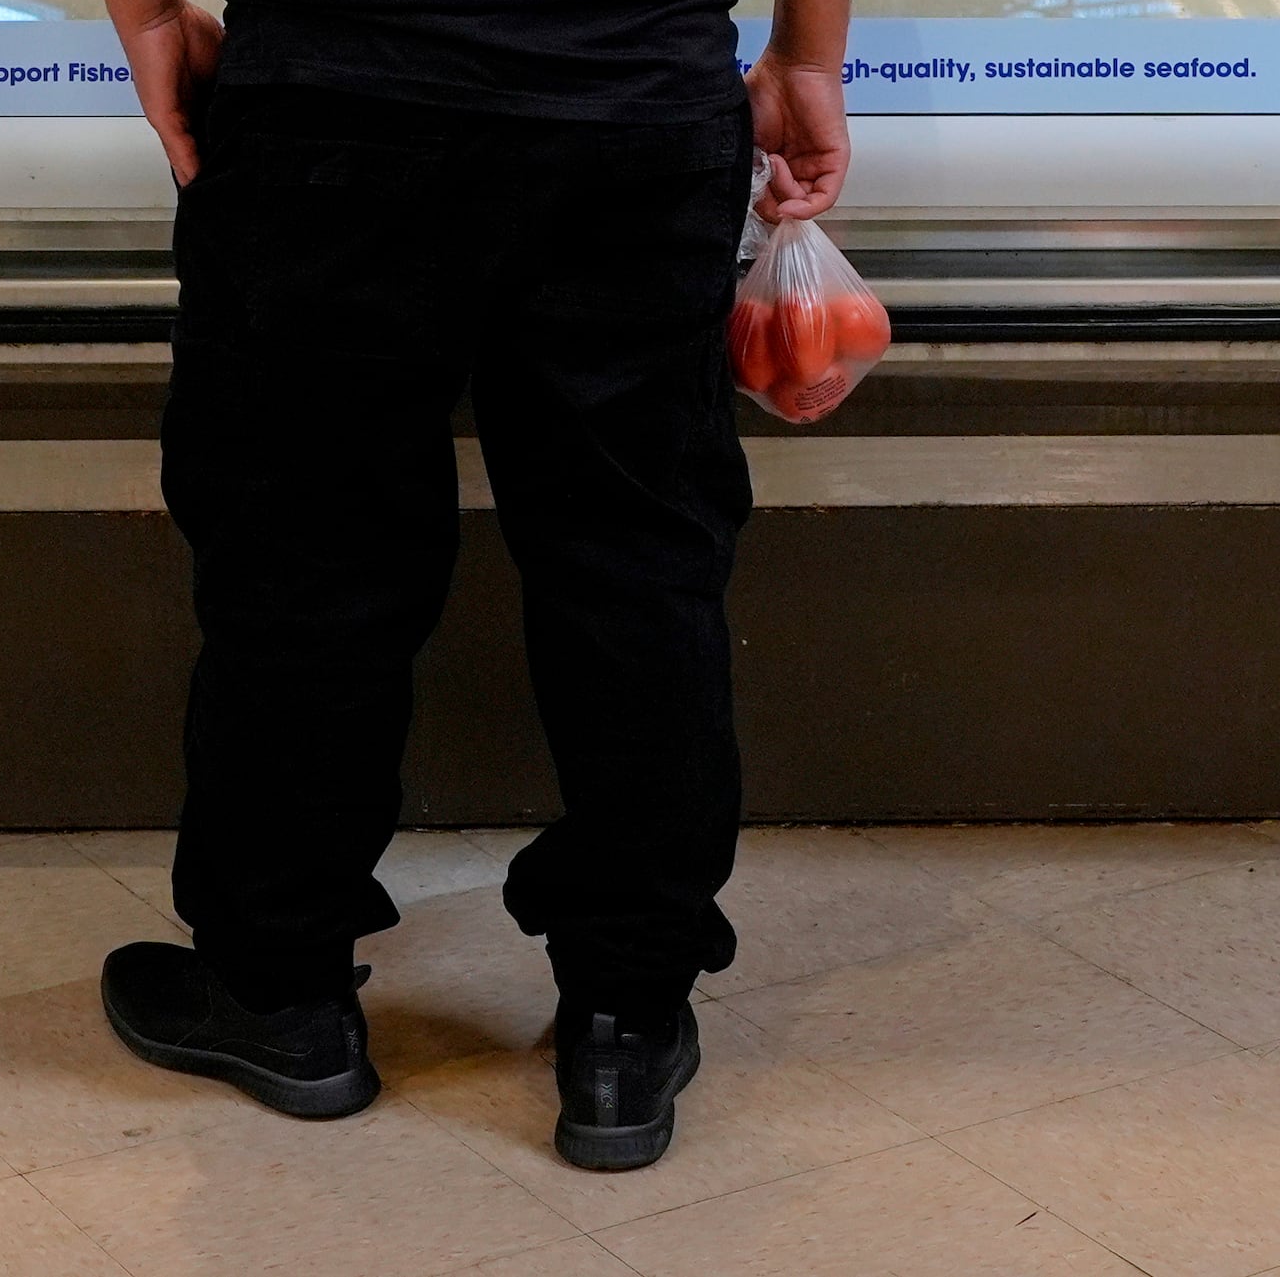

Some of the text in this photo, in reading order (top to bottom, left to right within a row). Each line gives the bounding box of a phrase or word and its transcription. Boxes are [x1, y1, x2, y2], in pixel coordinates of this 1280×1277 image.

[69, 62, 134, 83] Fishe
[985, 57, 1135, 78] sustainable
[1143, 57, 1257, 78] seafood.
